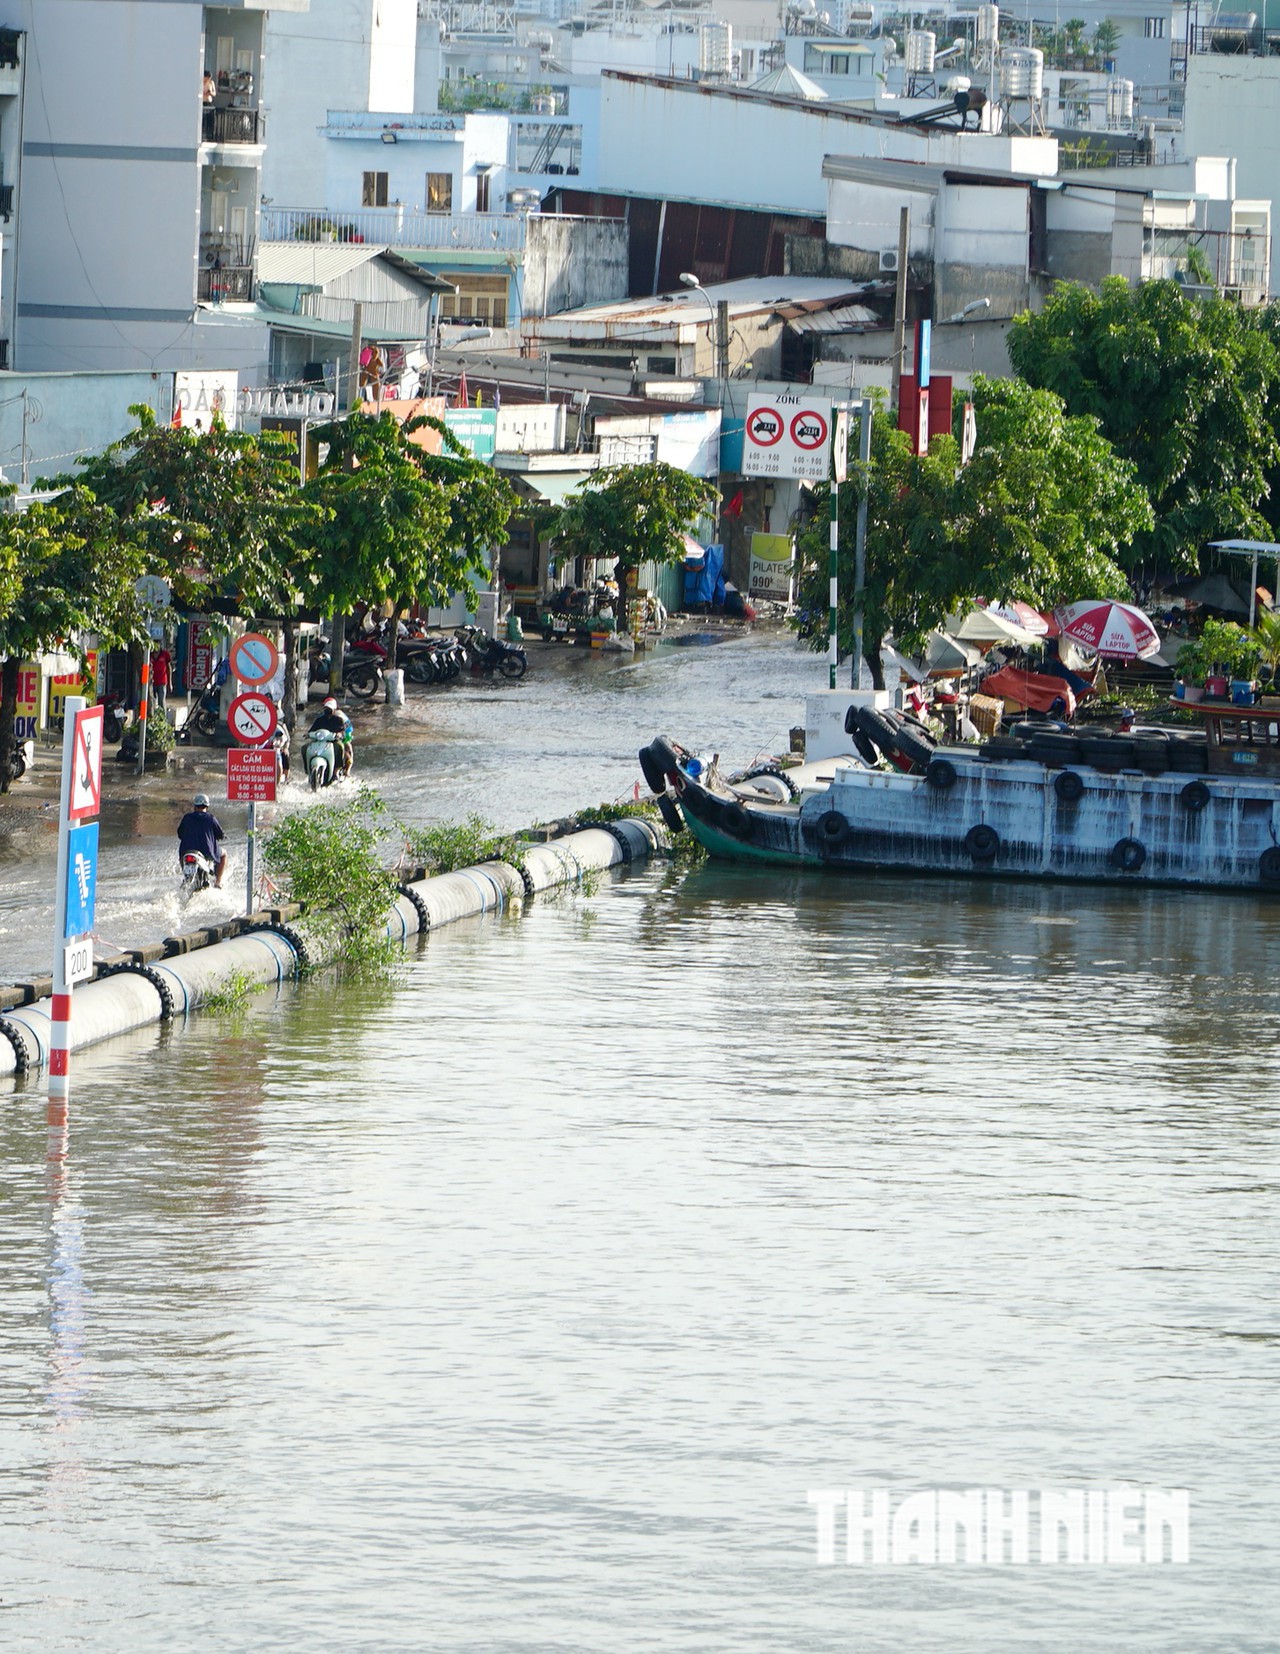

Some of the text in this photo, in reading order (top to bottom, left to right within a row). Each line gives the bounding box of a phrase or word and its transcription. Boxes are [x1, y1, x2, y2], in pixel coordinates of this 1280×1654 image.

[775, 394, 801, 405] ZONE
[753, 562, 789, 574] PILATES
[1072, 626, 1096, 643] LAPTOP
[1105, 640, 1131, 650] LAPTOP
[243, 752, 262, 763] CẤM
[71, 949, 88, 976] 200
